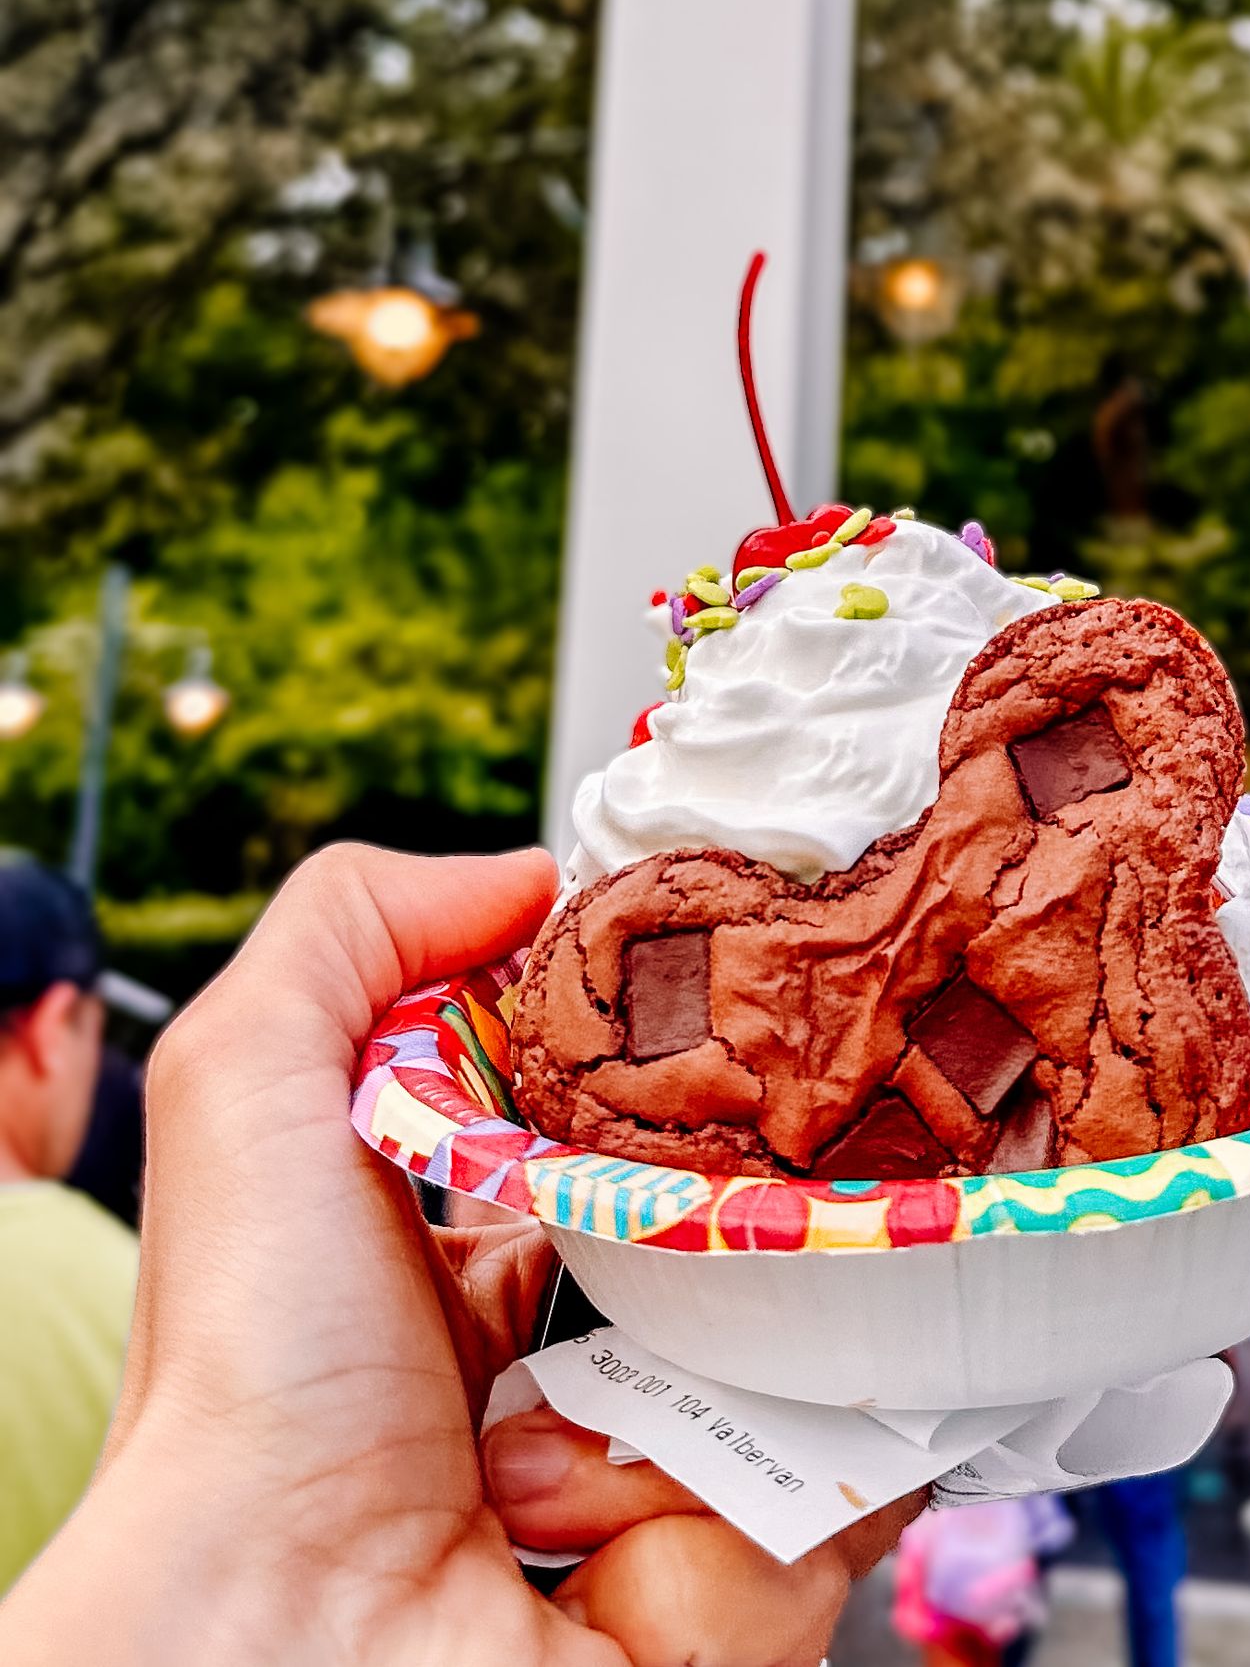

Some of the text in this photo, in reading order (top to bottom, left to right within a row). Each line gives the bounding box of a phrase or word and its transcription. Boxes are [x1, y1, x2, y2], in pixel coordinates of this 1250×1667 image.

[633, 1375, 672, 1397] 001
[669, 1394, 712, 1420] 104
[705, 1416, 805, 1493] Valbervan
